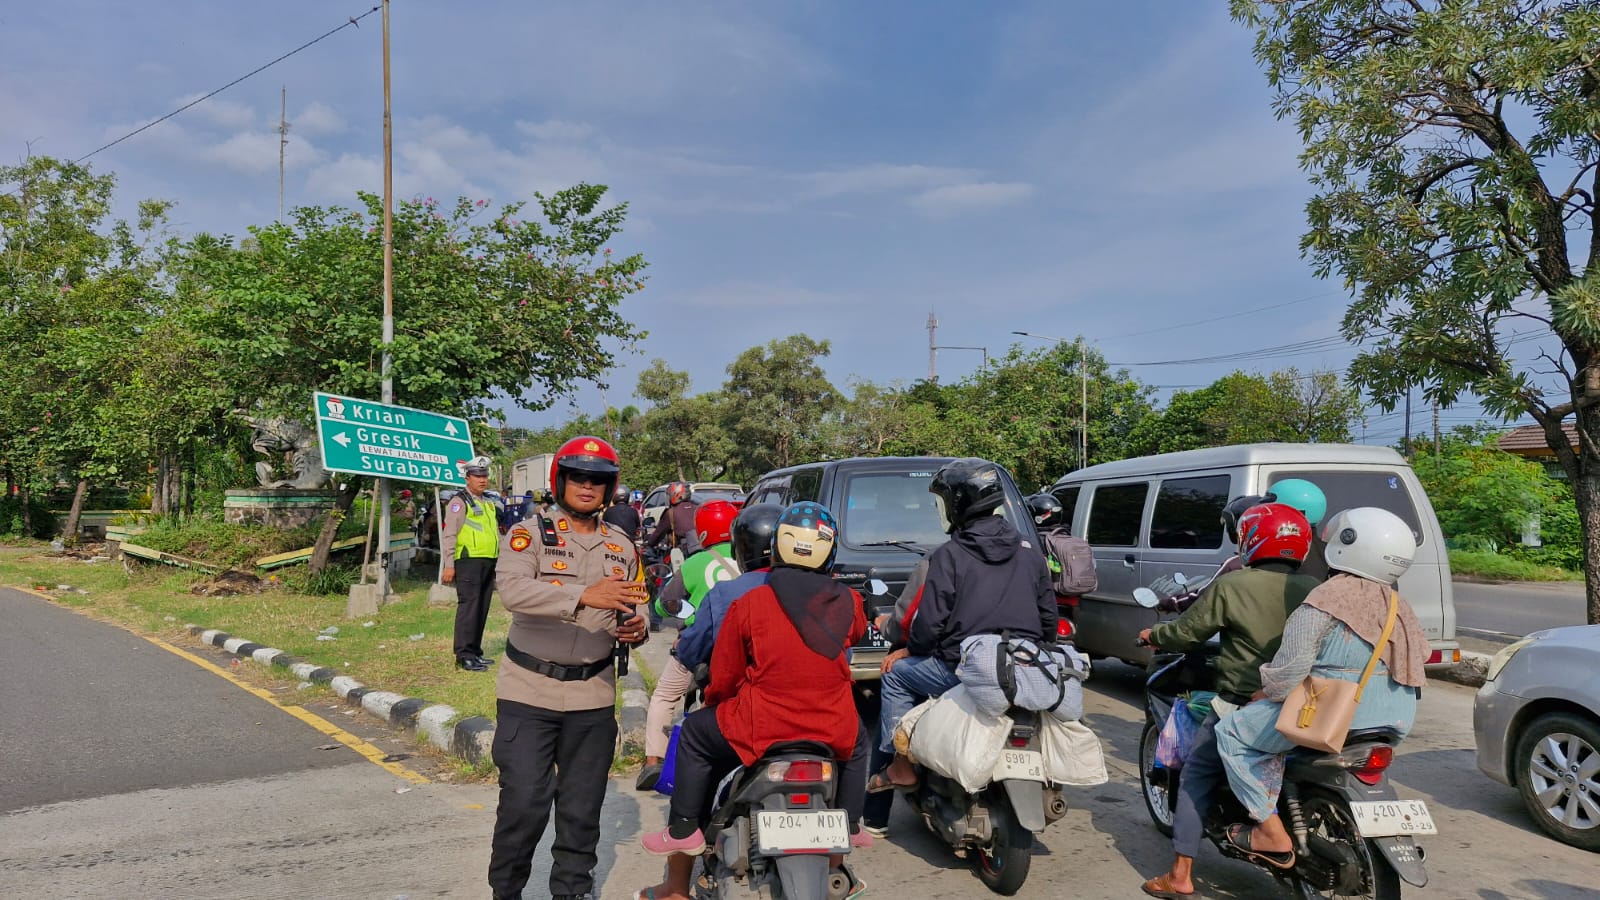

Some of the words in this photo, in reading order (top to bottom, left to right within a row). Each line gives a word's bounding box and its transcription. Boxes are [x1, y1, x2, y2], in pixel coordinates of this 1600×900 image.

[353, 405, 406, 426] Krian
[356, 428, 421, 449] Gresik
[362, 445, 393, 456] LEWAT
[398, 450, 425, 460] JALAN
[428, 454, 445, 463] TOL
[361, 455, 454, 481] Surabaya
[604, 553, 627, 565] POLRI
[1373, 804, 1402, 817] 4201
[1410, 804, 1428, 816] SA
[763, 815, 772, 828] W
[817, 815, 843, 828] NDY
